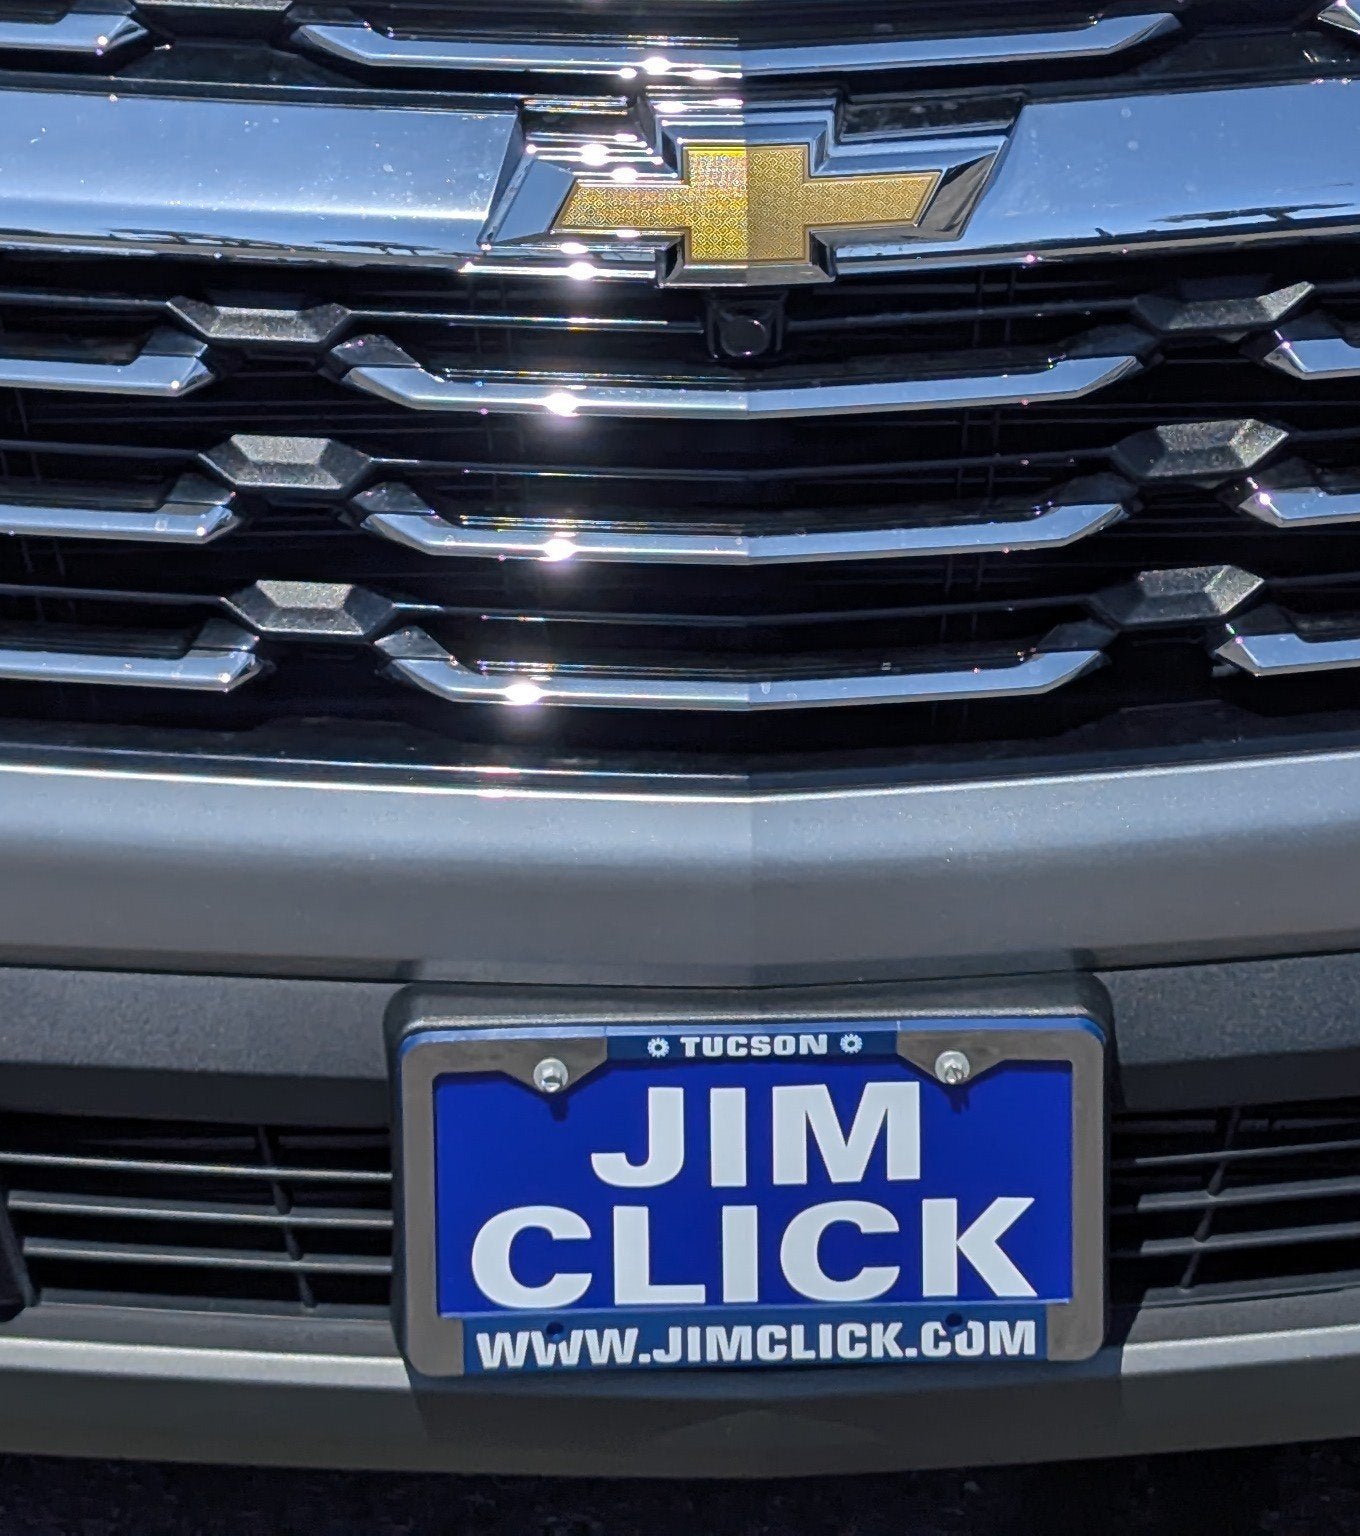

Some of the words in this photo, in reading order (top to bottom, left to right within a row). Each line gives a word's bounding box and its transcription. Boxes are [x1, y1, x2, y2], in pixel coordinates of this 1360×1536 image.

[679, 1034, 829, 1058] TUCSON
[591, 1081, 921, 1187] JIM
[471, 1196, 1038, 1308] CLICK
[476, 1320, 1036, 1369] WWW.JIMCLICK.COM
